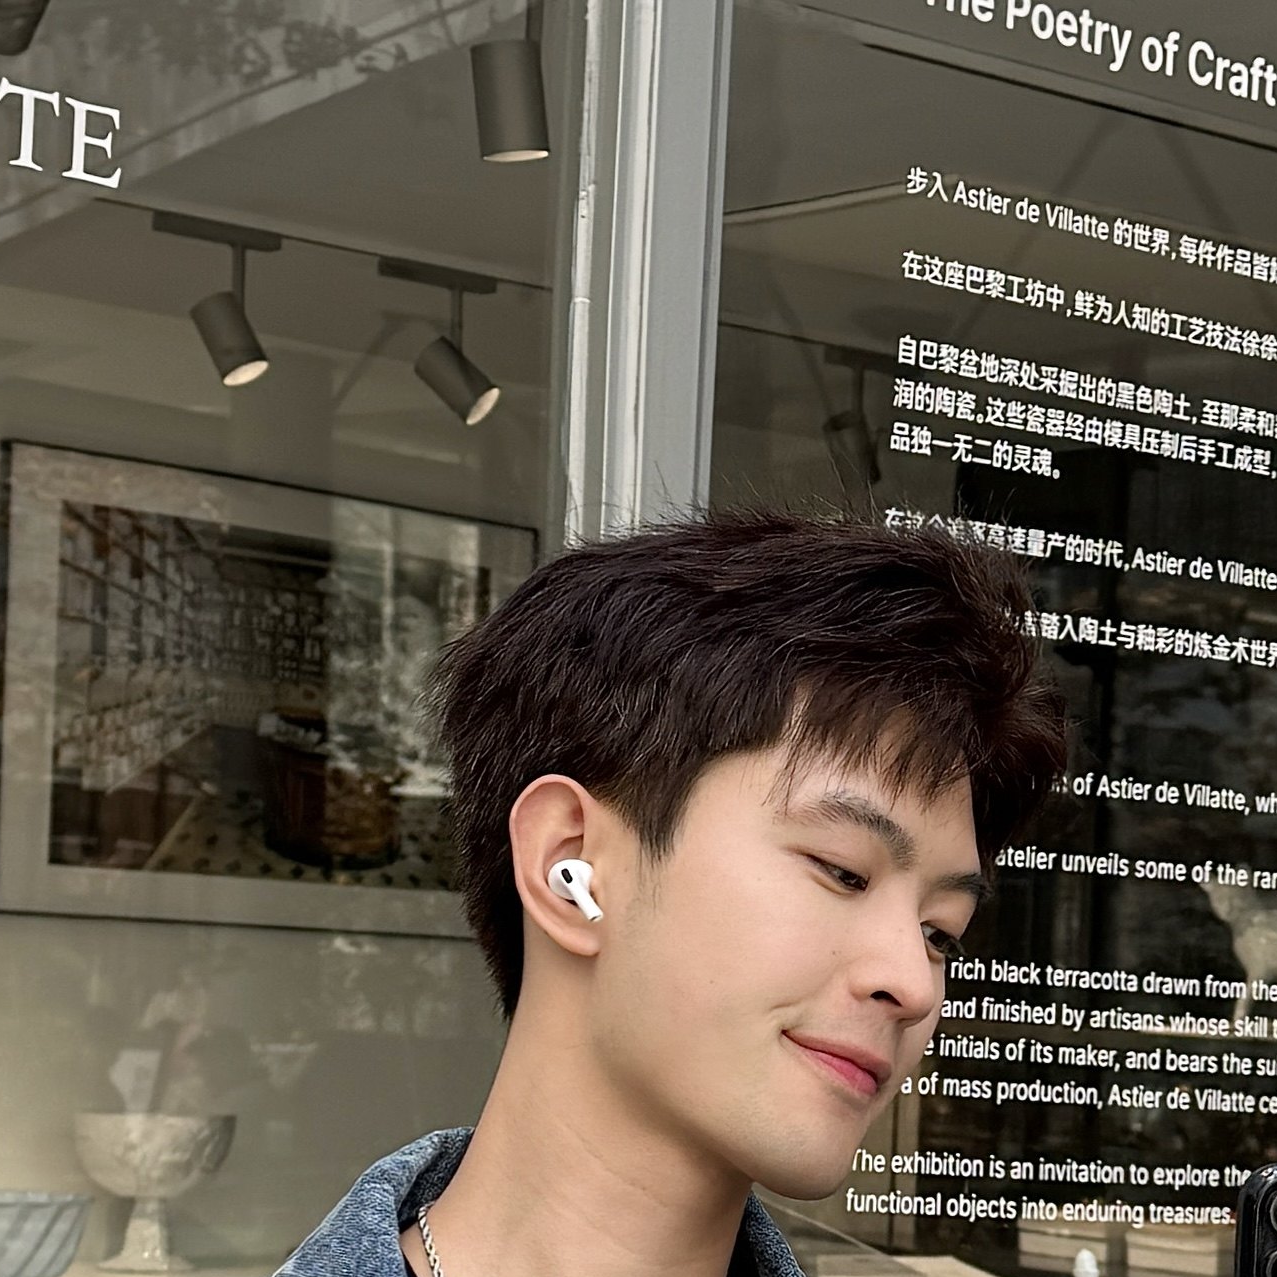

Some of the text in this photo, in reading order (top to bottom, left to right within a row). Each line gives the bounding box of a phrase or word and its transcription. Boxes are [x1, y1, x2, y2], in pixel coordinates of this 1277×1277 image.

[1006, 0, 1277, 107] Poetry of Craft
[906, 166, 948, 203] 步入
[953, 180, 1011, 216] Astier
[1015, 198, 1041, 225] de
[1045, 203, 1109, 241] Villatte
[890, 421, 1060, 479] 品独一无二的灵魂。
[1131, 547, 1186, 577] Astier
[1189, 556, 1213, 581] de
[1217, 560, 1277, 590] Villatte
[1073, 774, 1093, 795] of
[1097, 776, 1151, 801] Astier
[1156, 782, 1179, 804] de
[1184, 784, 1249, 815] Villatte,
[1062, 852, 1129, 876] unveils
[1135, 860, 1186, 882] some
[1192, 860, 1212, 884] of
[1217, 864, 1248, 887] the
[951, 957, 985, 981] rich
[991, 960, 1040, 985] black
[1046, 965, 1137, 992] terracotta
[1143, 972, 1199, 996] drawn
[1205, 975, 1247, 1001] from
[941, 999, 976, 1018] and
[982, 997, 1056, 1024] finished
[1062, 1003, 1084, 1032] by
[1090, 1007, 1163, 1031] artisans
[1169, 1016, 1230, 1035] whose
[1234, 1015, 1268, 1038] skill
[940, 1033, 999, 1060] initials
[1005, 1038, 1025, 1061] of
[1031, 1039, 1053, 1063] its
[1059, 1044, 1119, 1072] maker,
[1126, 1048, 1160, 1070] and
[1166, 1049, 1217, 1073] bears
[1223, 1052, 1252, 1075] the
[918, 1073, 938, 1095] of
[943, 1079, 991, 1098] mass
[997, 1080, 1102, 1109] production,
[1108, 1084, 1162, 1109] Astier
[1167, 1088, 1190, 1110] de
[1195, 1089, 1255, 1113] Villatte
[891, 1151, 983, 1177] exhibition
[990, 1155, 1005, 1178] is
[1010, 1161, 1033, 1180] an
[1039, 1157, 1124, 1184] invitation
[1130, 1164, 1148, 1185] to
[1154, 1164, 1219, 1190] explore
[846, 1190, 1236, 1228] functional objects into enduring treasures.
